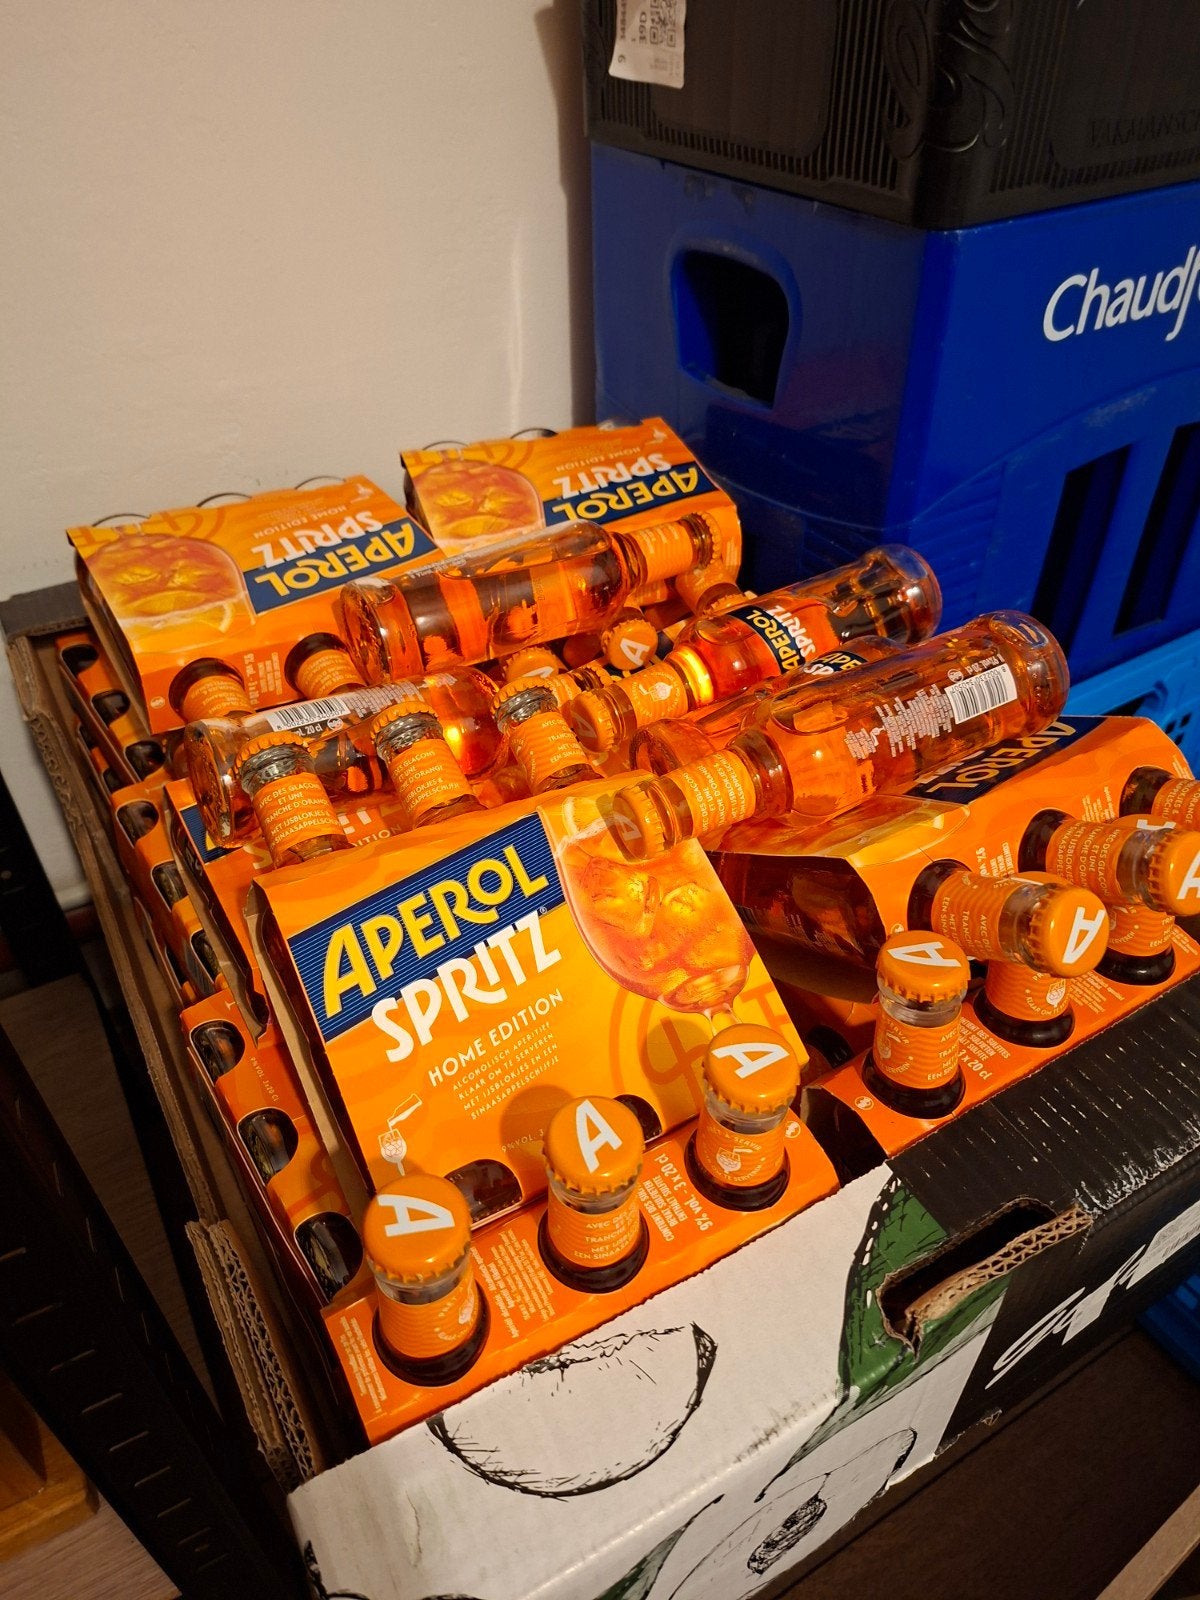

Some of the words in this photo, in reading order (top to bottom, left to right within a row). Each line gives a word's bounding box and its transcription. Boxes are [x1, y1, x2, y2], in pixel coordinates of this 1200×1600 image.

[552, 453, 672, 499] SPRITZ
[552, 467, 699, 522] APEROL
[251, 511, 385, 568] SPRITZ
[254, 523, 416, 597] APEROL
[620, 637, 650, 667] A
[746, 609, 800, 671] APEROL
[767, 605, 816, 657] SPRITZ
[820, 651, 861, 670] APE
[927, 720, 1077, 794] APEROL
[1088, 855, 1097, 872] UNE
[1099, 843, 1110, 859] DES
[324, 844, 549, 1019] APEROL
[979, 914, 988, 937] AVEC
[1062, 907, 1106, 964] A
[887, 941, 962, 968] A
[371, 909, 562, 1064] SPRITZ
[427, 1037, 487, 1087] HOME
[489, 988, 564, 1048] EDITION
[712, 1042, 790, 1079] A
[452, 1049, 511, 1092] ALCOHOLISCH
[458, 1078, 486, 1101] KLAAR
[488, 1066, 503, 1083] OM
[514, 1033, 554, 1066] SERVEREN
[463, 1094, 482, 1112] MET
[482, 1061, 530, 1099] IJSBLOKJES
[967, 1057, 984, 1074] 20
[979, 1067, 993, 1081] cl
[576, 1099, 623, 1174] A
[654, 1152, 669, 1166] cl
[660, 1161, 678, 1178] 20
[377, 1194, 456, 1237] A
[694, 1212, 714, 1232] 9%
